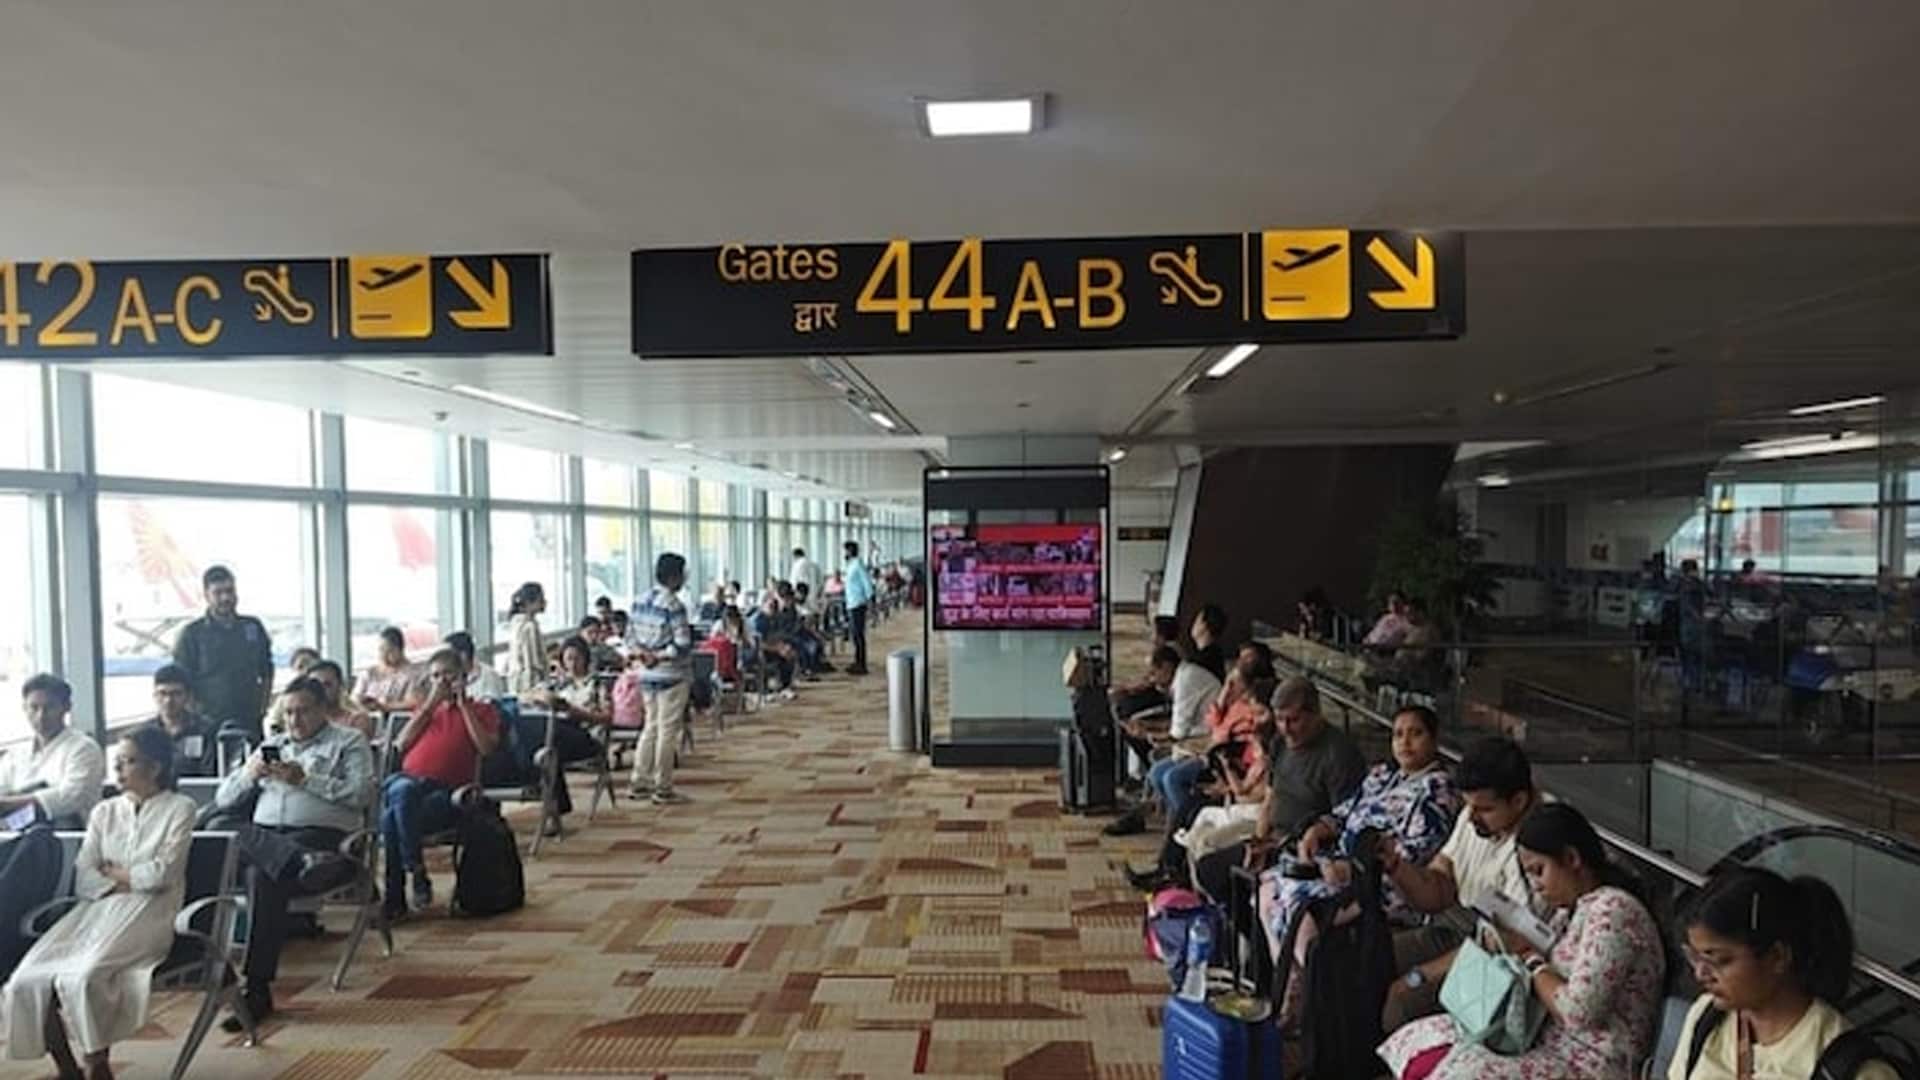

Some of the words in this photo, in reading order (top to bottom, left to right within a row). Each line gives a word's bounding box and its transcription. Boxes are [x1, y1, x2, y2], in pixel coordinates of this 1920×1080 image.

[718, 242, 839, 282] Gates
[855, 238, 996, 332] 44
[1006, 259, 1127, 331] A-B
[110, 275, 223, 346] A-C
[794, 302, 838, 332] द्वार
